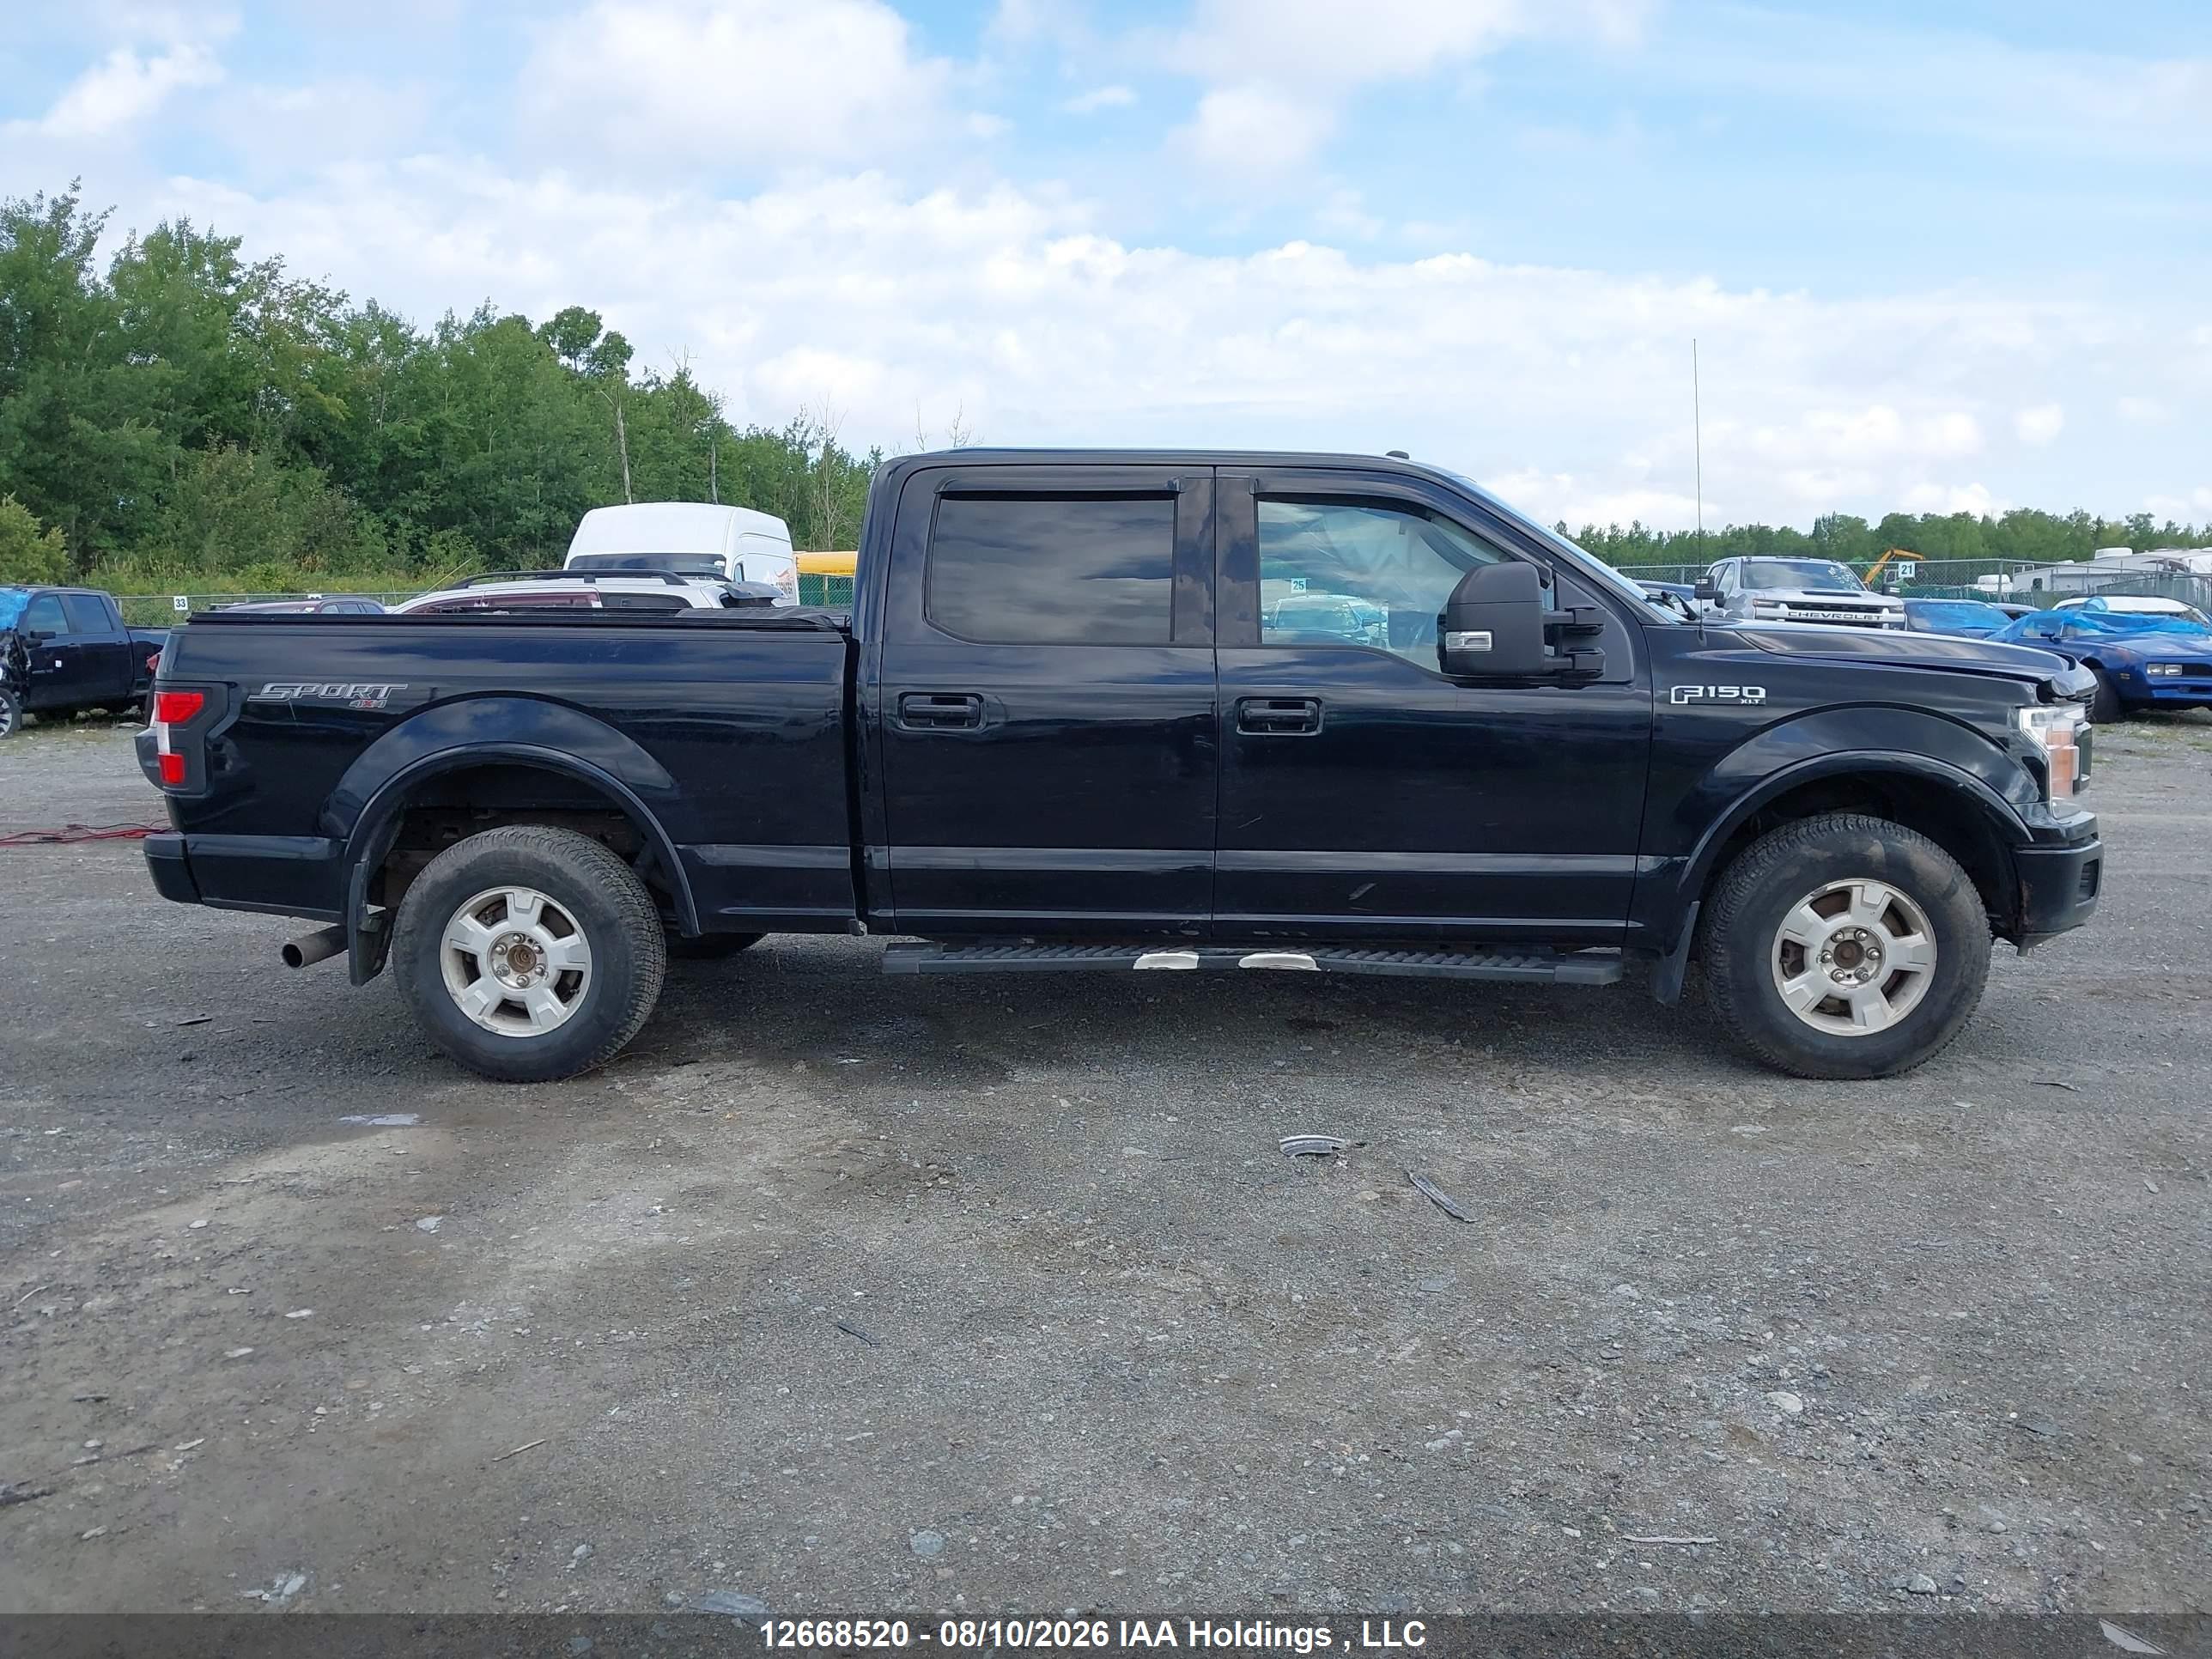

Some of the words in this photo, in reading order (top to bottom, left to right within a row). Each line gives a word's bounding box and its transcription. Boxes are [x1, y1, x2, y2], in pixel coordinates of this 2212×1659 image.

[1900, 564, 1913, 575] 21
[1292, 580, 1304, 591] 25
[175, 598, 186, 608] 33
[1788, 611, 1883, 621] CHEVROLET
[247, 683, 409, 702] SPORT
